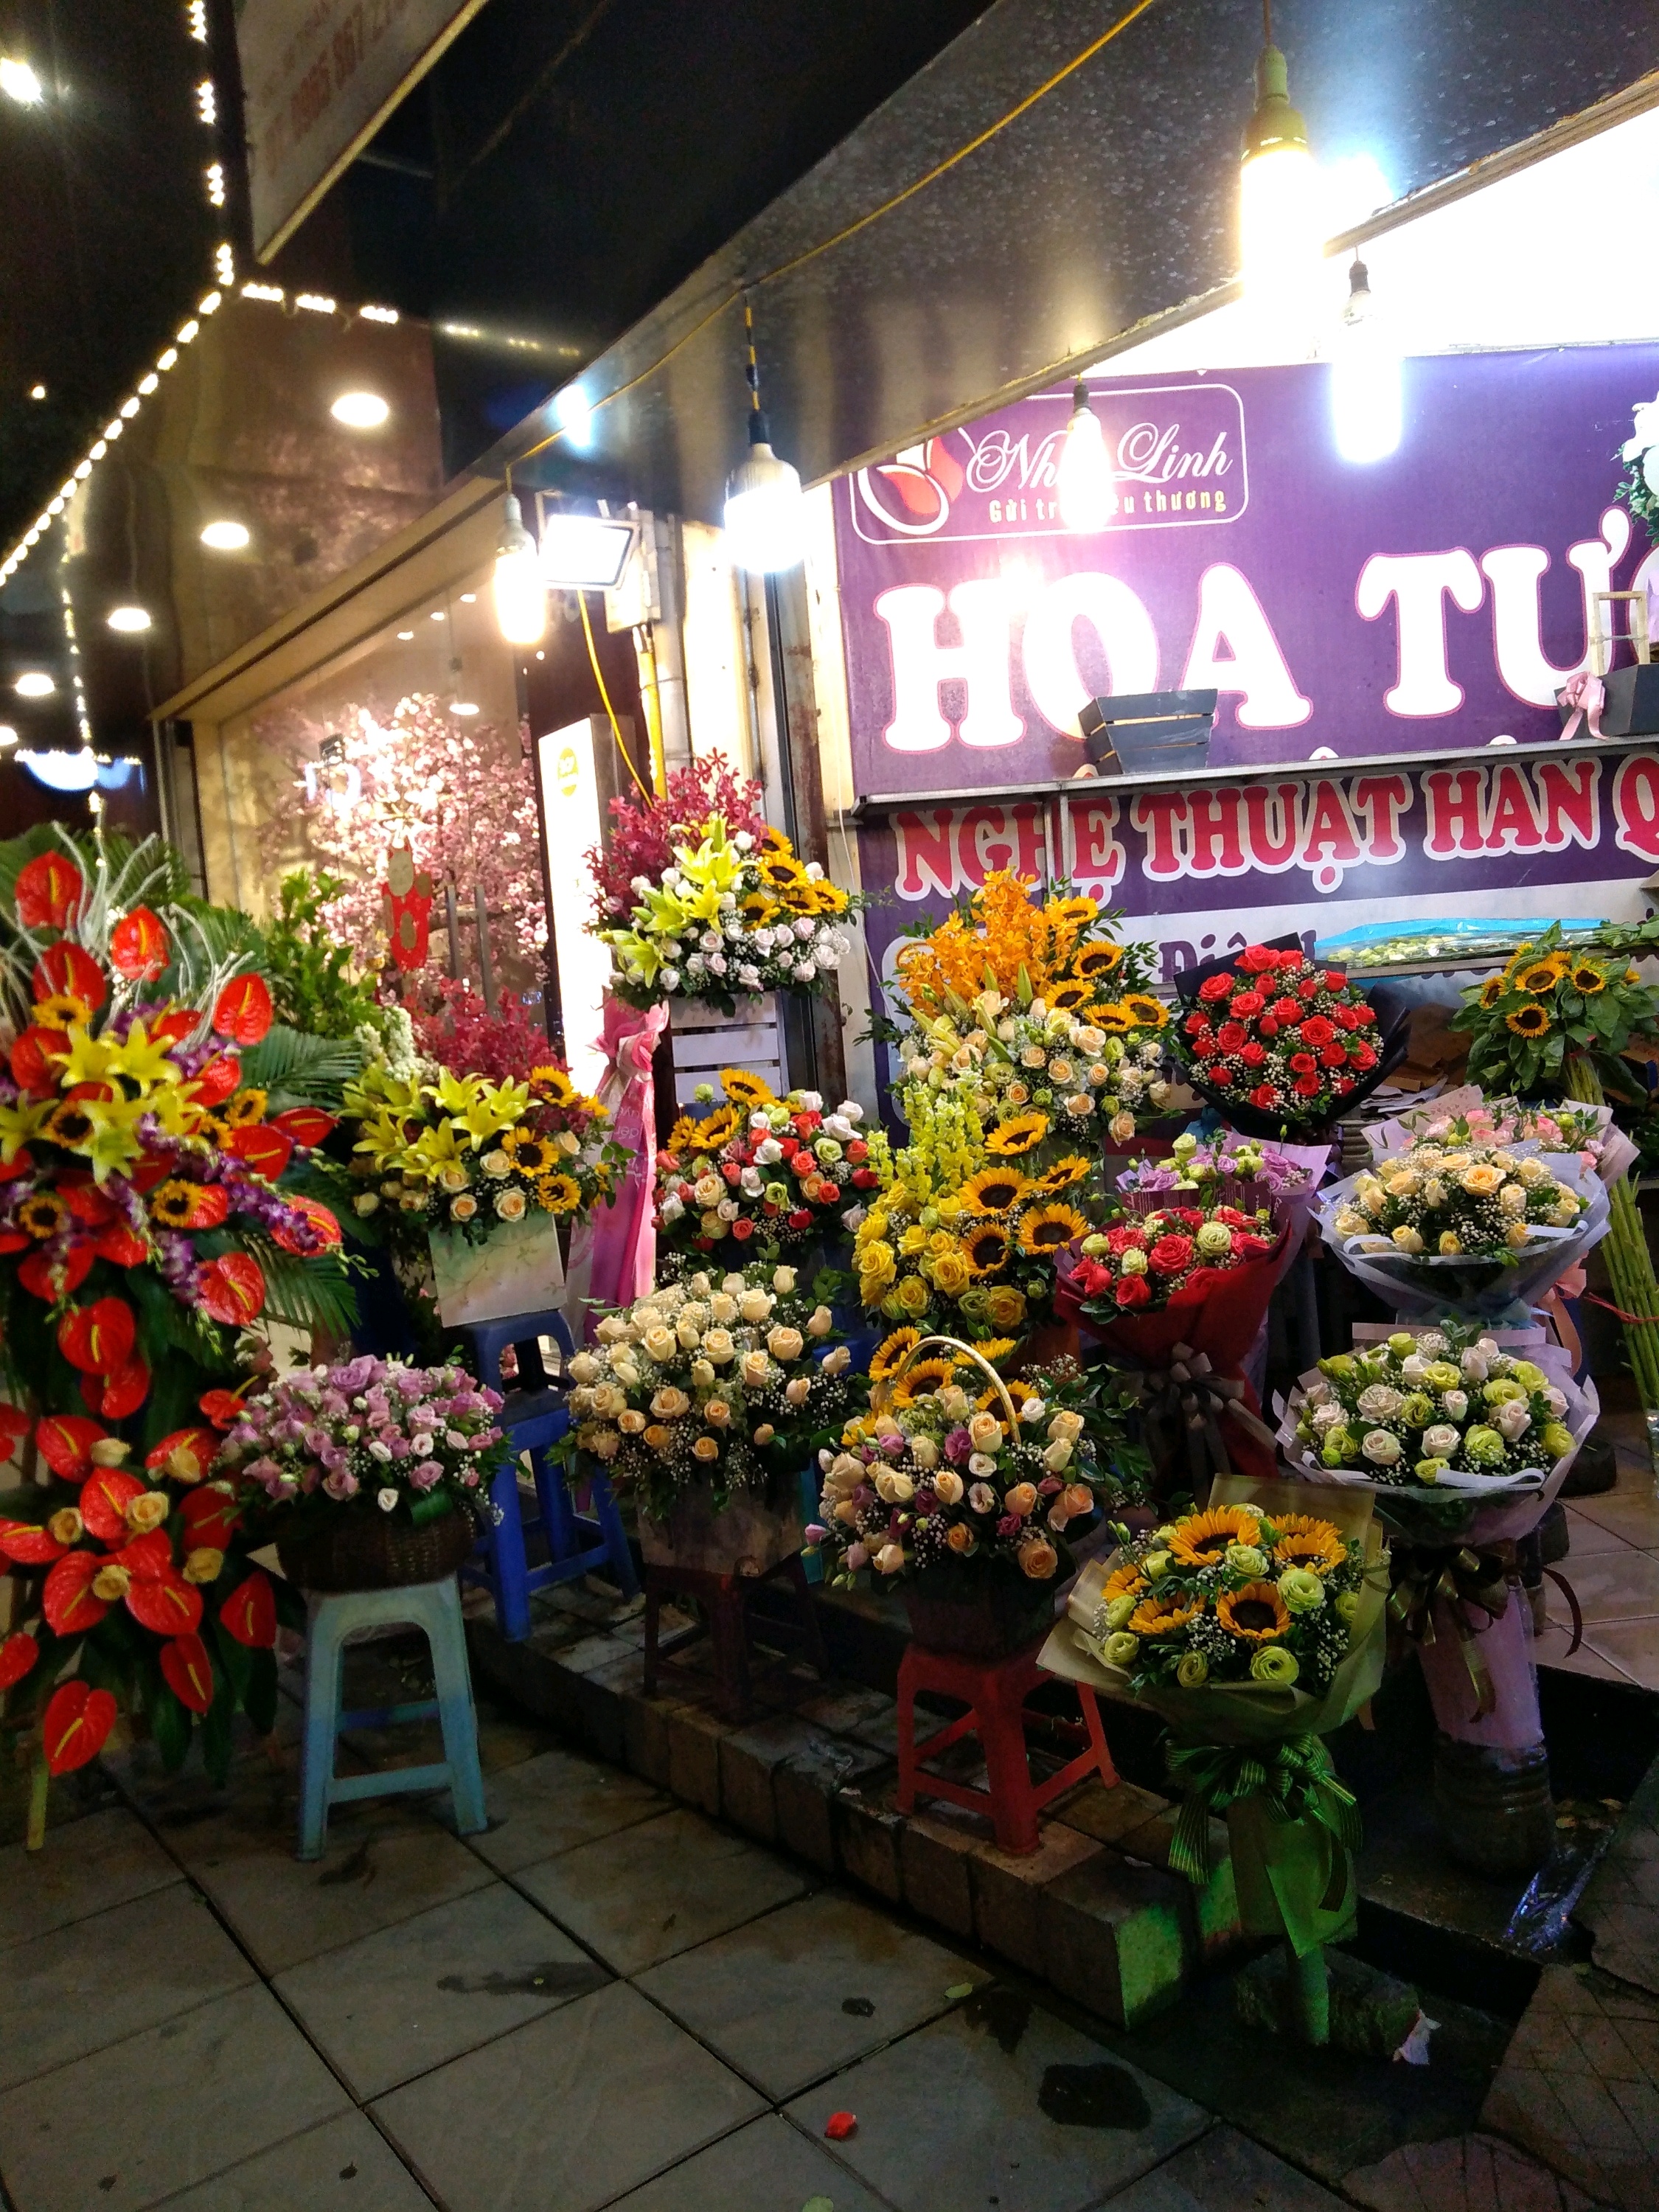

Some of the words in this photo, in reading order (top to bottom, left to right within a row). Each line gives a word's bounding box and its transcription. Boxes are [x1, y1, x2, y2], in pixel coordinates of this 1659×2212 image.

[1110, 422, 1234, 484] Linh
[989, 498, 1028, 523] Gửi
[1144, 490, 1227, 515] thương
[873, 561, 1314, 752] HOA
